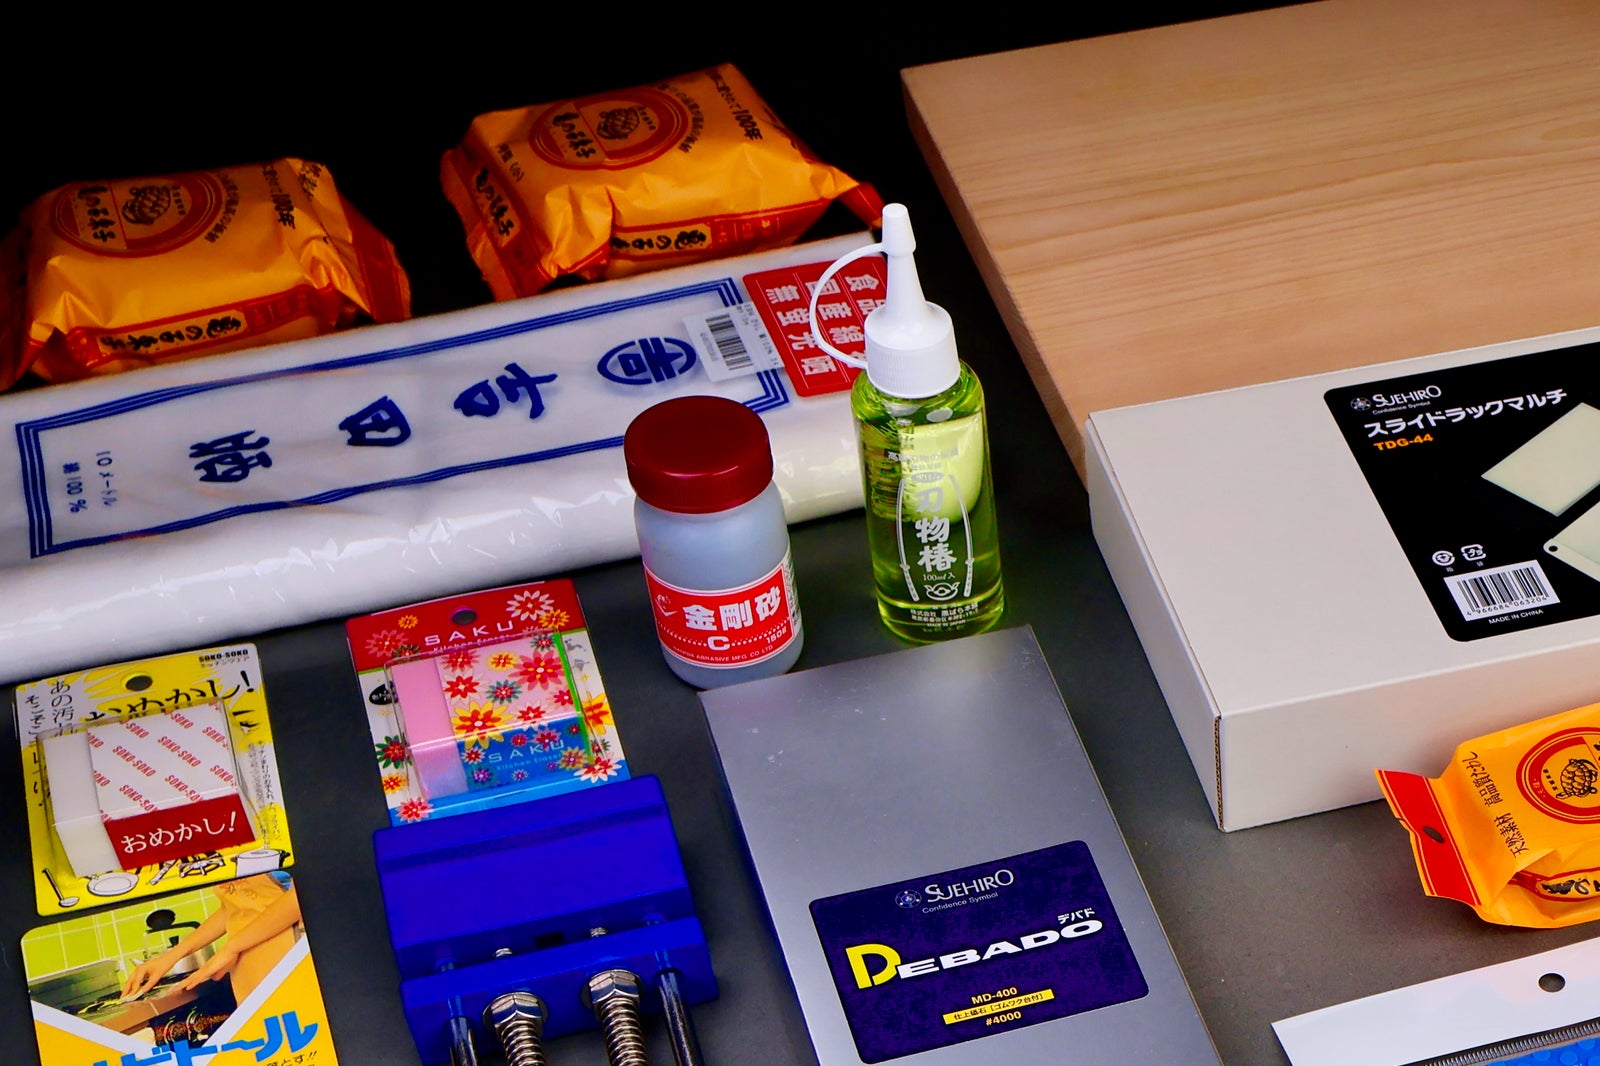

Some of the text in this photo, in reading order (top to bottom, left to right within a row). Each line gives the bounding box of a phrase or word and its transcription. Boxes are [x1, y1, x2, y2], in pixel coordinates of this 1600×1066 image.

[1372, 385, 1442, 408] SUEHIRO
[1364, 388, 1568, 438] スライドラックマルチ
[1373, 433, 1434, 451] TDG-44
[914, 487, 957, 573] 刃物椿
[682, 585, 781, 631] 金剛砂
[1489, 615, 1511, 624] MADE
[1520, 609, 1544, 619] CHINA
[424, 620, 514, 647] SAKU
[707, 636, 730, 651] C
[199, 649, 249, 662] SOKO-SOKO
[112, 745, 156, 777] SOKO-SOKO
[157, 735, 201, 768] SOKO-SOKO
[488, 739, 565, 764] SAKU
[1463, 751, 1530, 859] 天然素材 高品質たわし
[121, 811, 237, 854] おめかし!
[924, 869, 1015, 903] SUEHIRO
[922, 891, 999, 914] Confidence Symbol
[1057, 908, 1096, 925] デバド
[845, 919, 1103, 990] DEBADO
[971, 986, 1019, 1006] MD-400
[985, 1010, 1022, 1027] #4000
